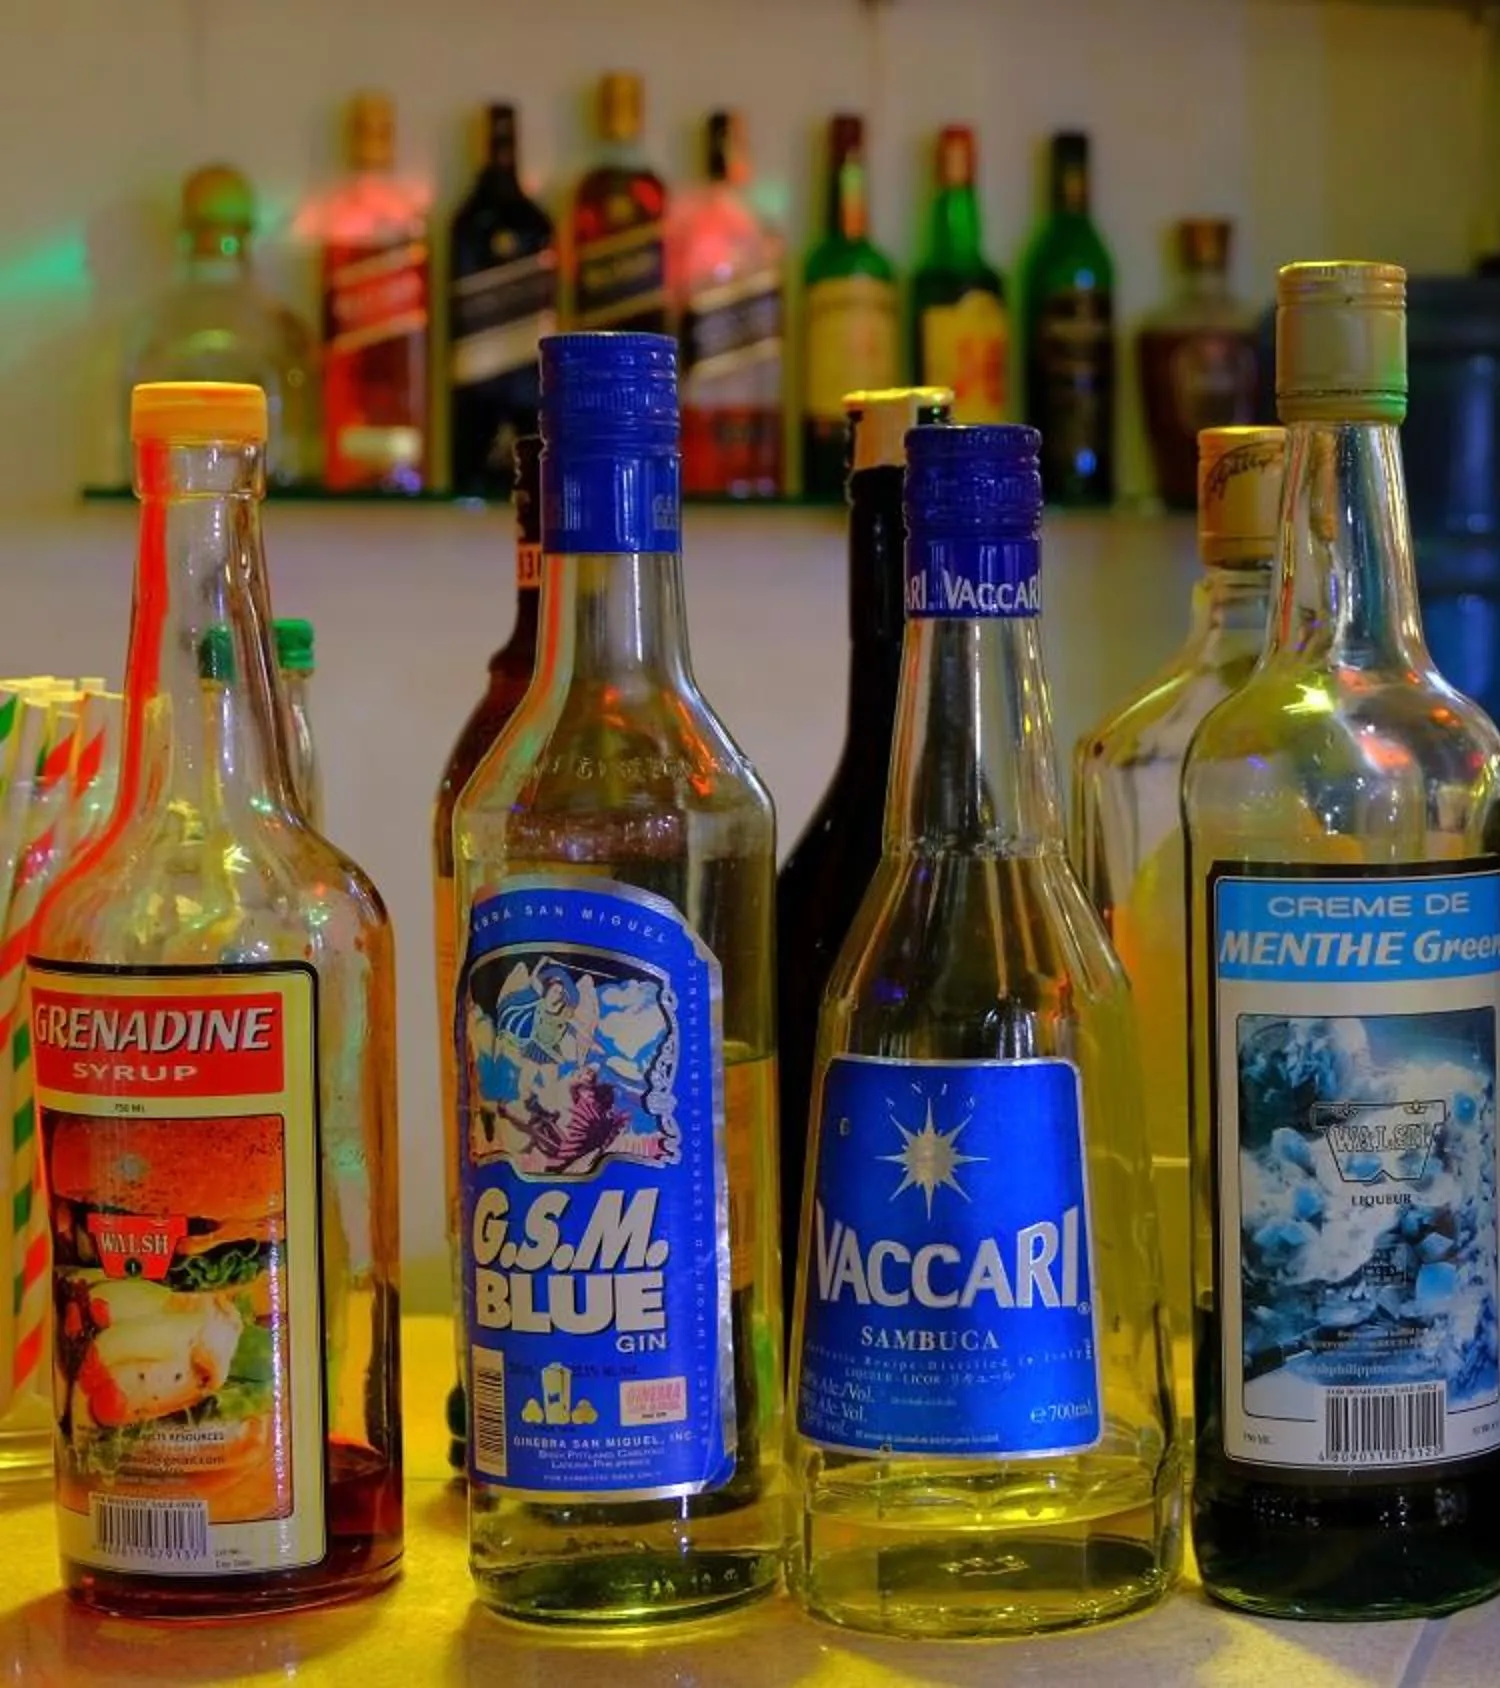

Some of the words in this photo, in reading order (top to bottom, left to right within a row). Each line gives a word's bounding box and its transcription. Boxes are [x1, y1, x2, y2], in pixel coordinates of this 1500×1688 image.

[1266, 895, 1413, 919] CREME
[1425, 892, 1471, 916] DE
[1219, 929, 1407, 967] MENTHE
[34, 1002, 275, 1054] GRENADINE
[72, 1061, 200, 1083] SYRUP
[1331, 1122, 1433, 1153] WALSH
[1350, 1193, 1413, 1208] LIQUEUR
[471, 1186, 670, 1272] G.S.M.
[100, 1232, 170, 1256] WALSH
[815, 1197, 1080, 1310] VACCARI
[475, 1266, 668, 1336] BLUE
[615, 1331, 668, 1354] GIN
[860, 1325, 1000, 1351] SAMBUCA
[513, 1434, 567, 1449] GINEBRA
[571, 1437, 601, 1449] SAN
